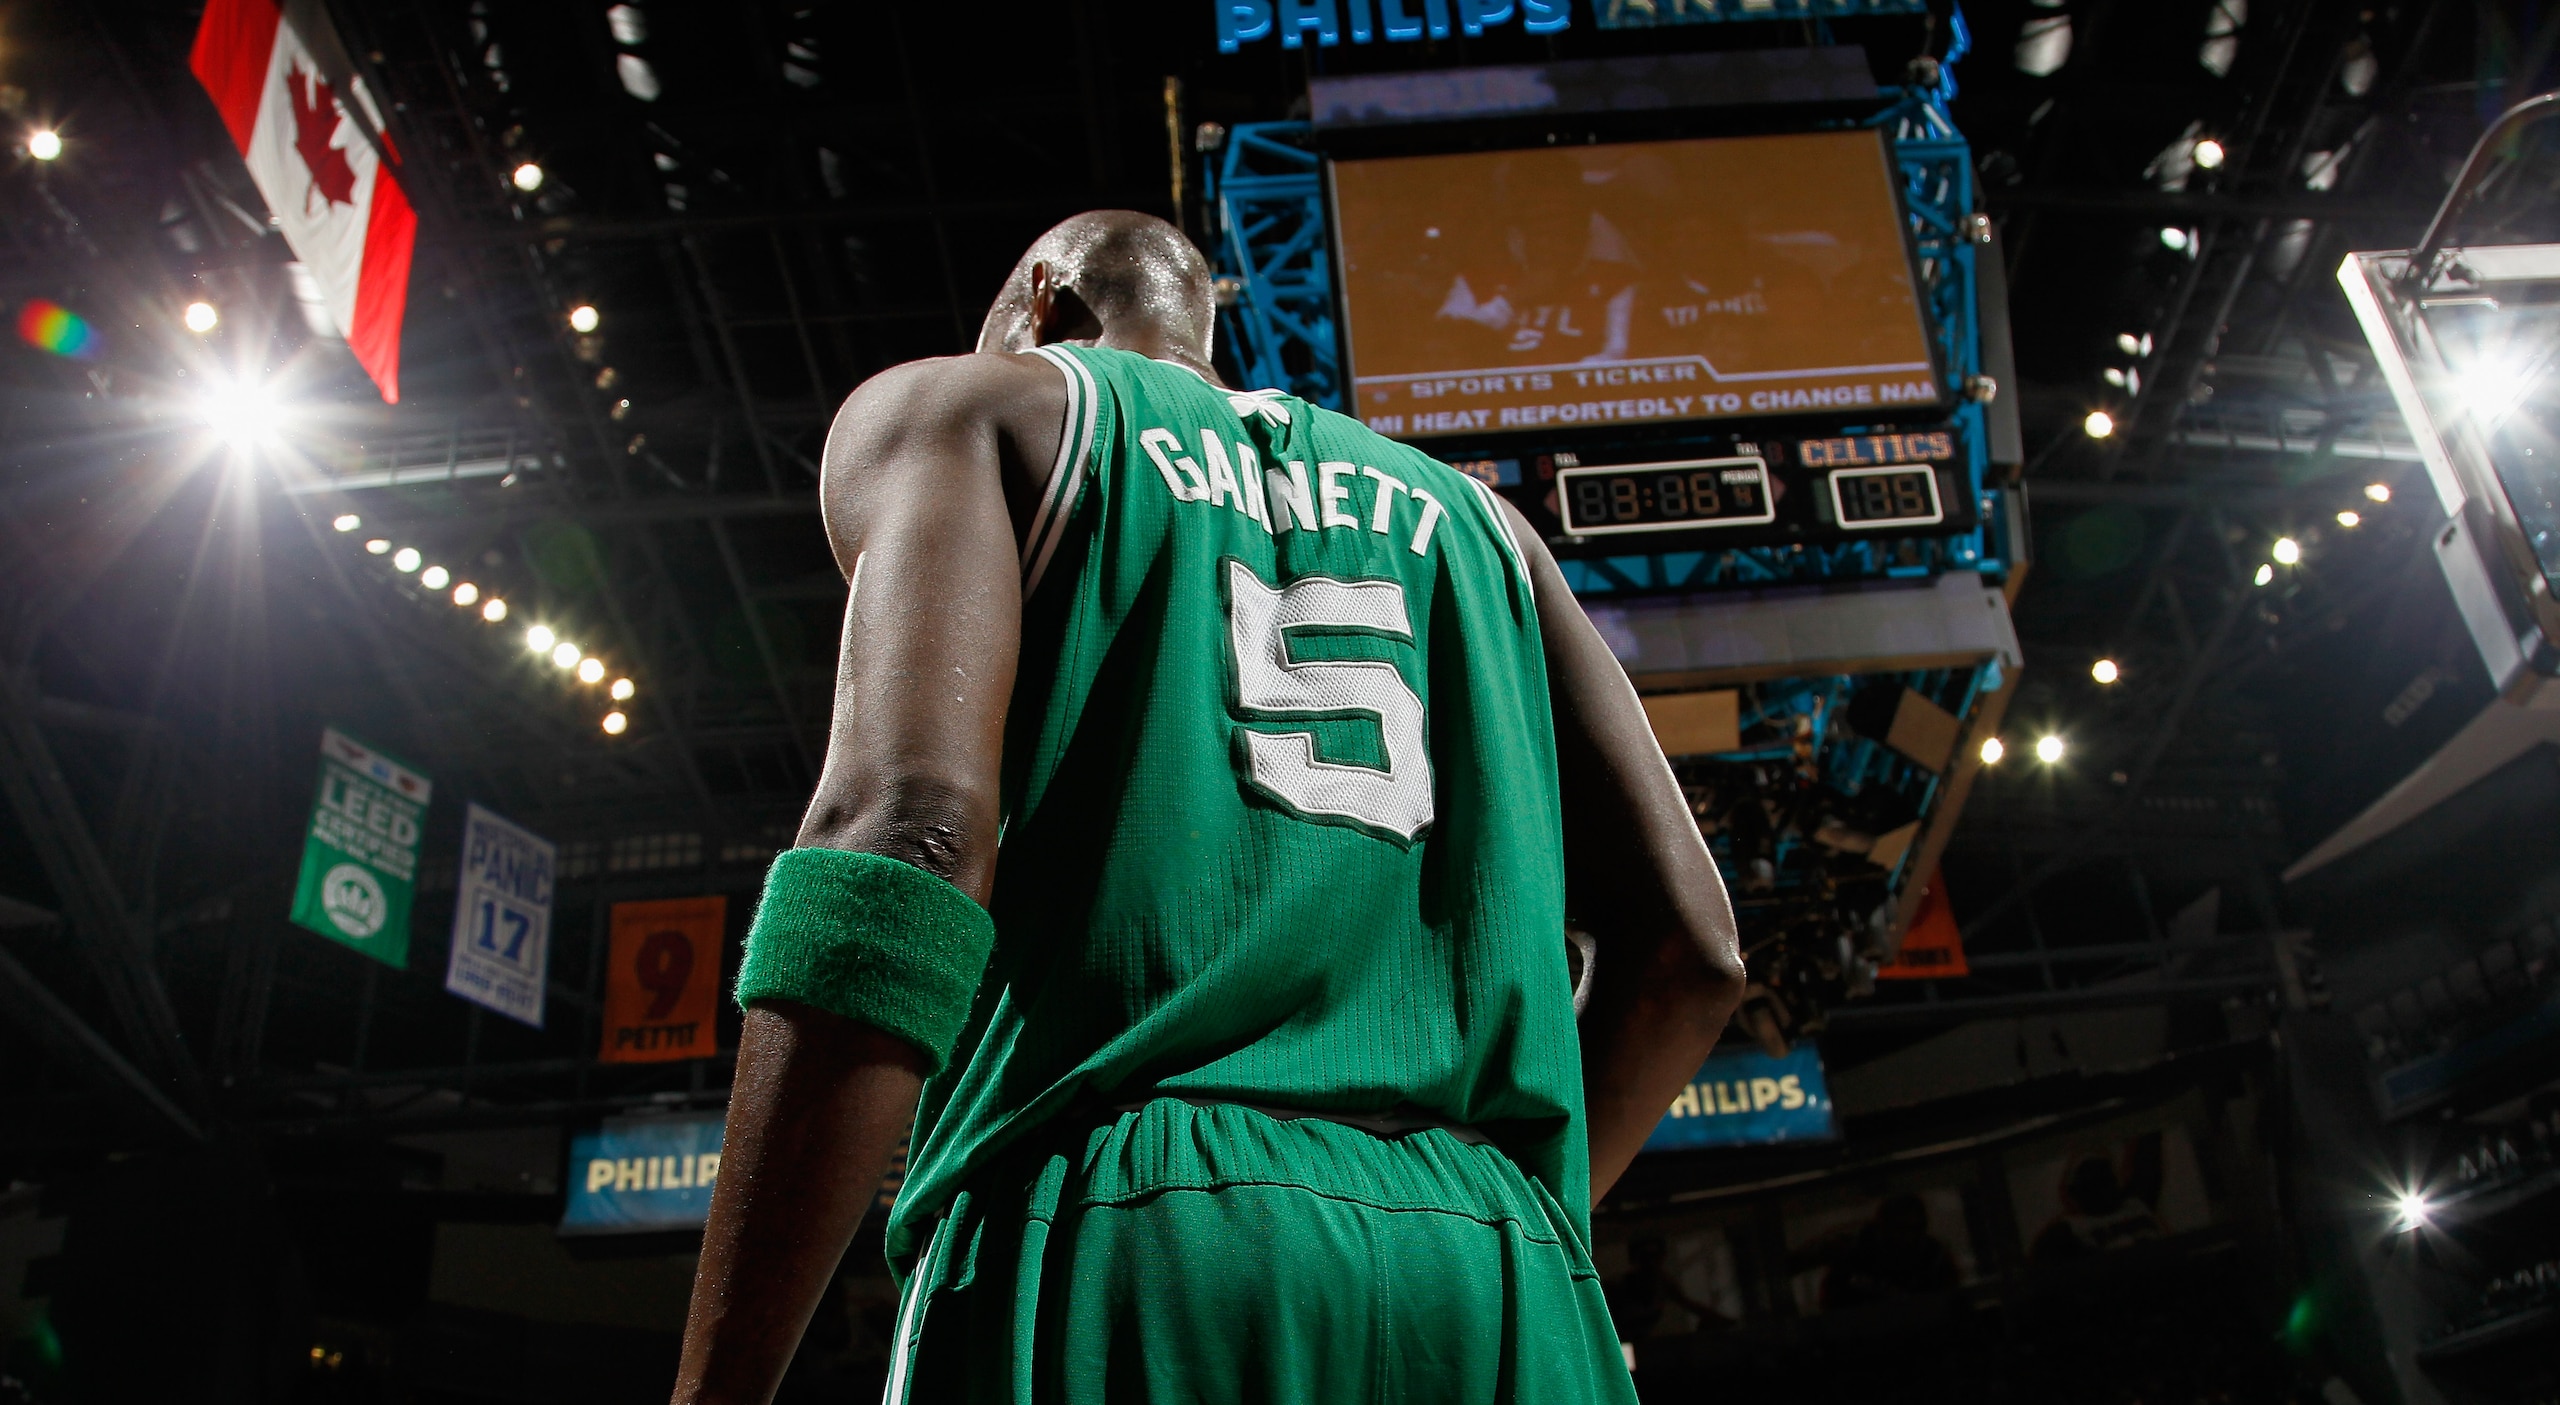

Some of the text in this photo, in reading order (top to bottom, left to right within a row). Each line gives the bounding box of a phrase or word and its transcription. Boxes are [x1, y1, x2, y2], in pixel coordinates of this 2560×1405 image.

[1410, 364, 1696, 398] SPORTS TICKER
[1412, 409, 1491, 432] HEAT
[1501, 396, 1693, 426] REPORTEDLY
[1702, 393, 1742, 412] TO
[1753, 385, 1873, 410] CHANGE
[1801, 432, 1951, 468] CELTICS
[1139, 427, 1450, 556] GARNETT
[1226, 558, 1436, 844] 5
[320, 775, 419, 847] LEED
[478, 900, 530, 962] 17
[636, 929, 695, 1020] 9
[615, 1020, 700, 1050] PETTIT
